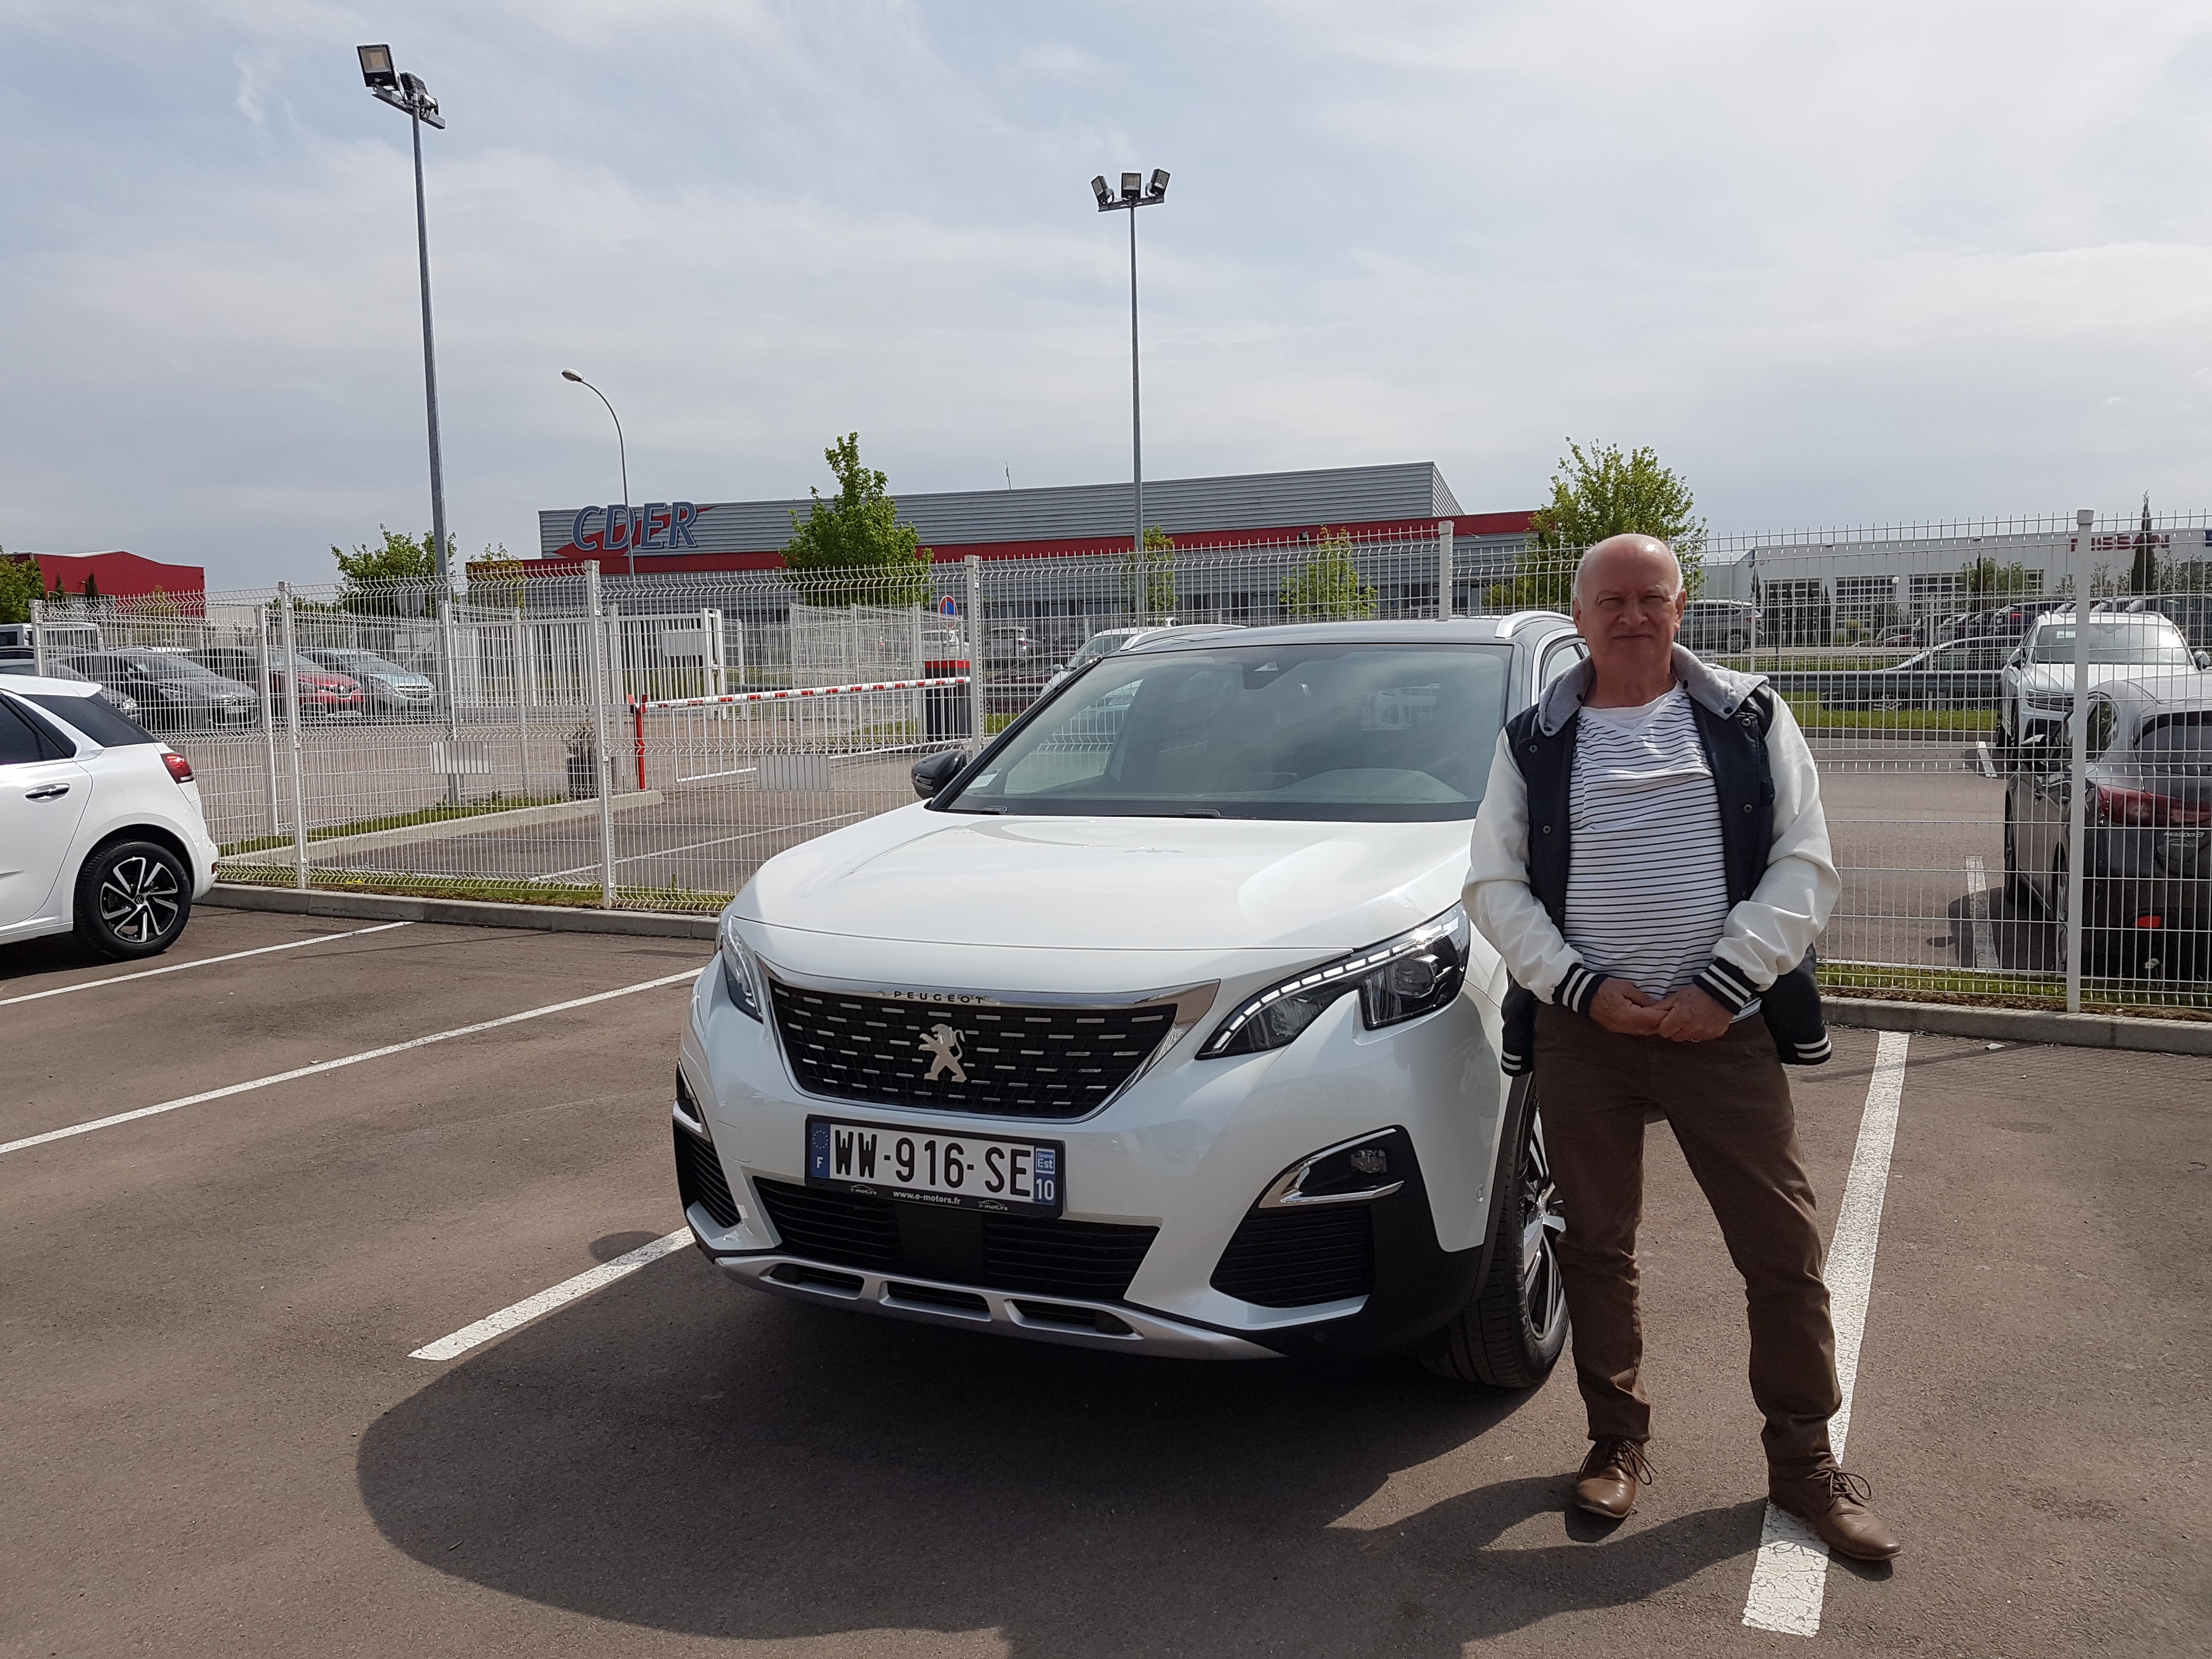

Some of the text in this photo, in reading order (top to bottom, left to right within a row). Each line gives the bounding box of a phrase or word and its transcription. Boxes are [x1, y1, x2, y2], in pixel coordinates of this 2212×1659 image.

[572, 501, 698, 551] CDER
[894, 990, 984, 1004] PEUGEOT
[816, 1156, 824, 1169] F
[1037, 1158, 1053, 1169] Est
[1036, 1178, 1054, 1201] 10
[893, 1190, 962, 1205] www.e-motors.fr
